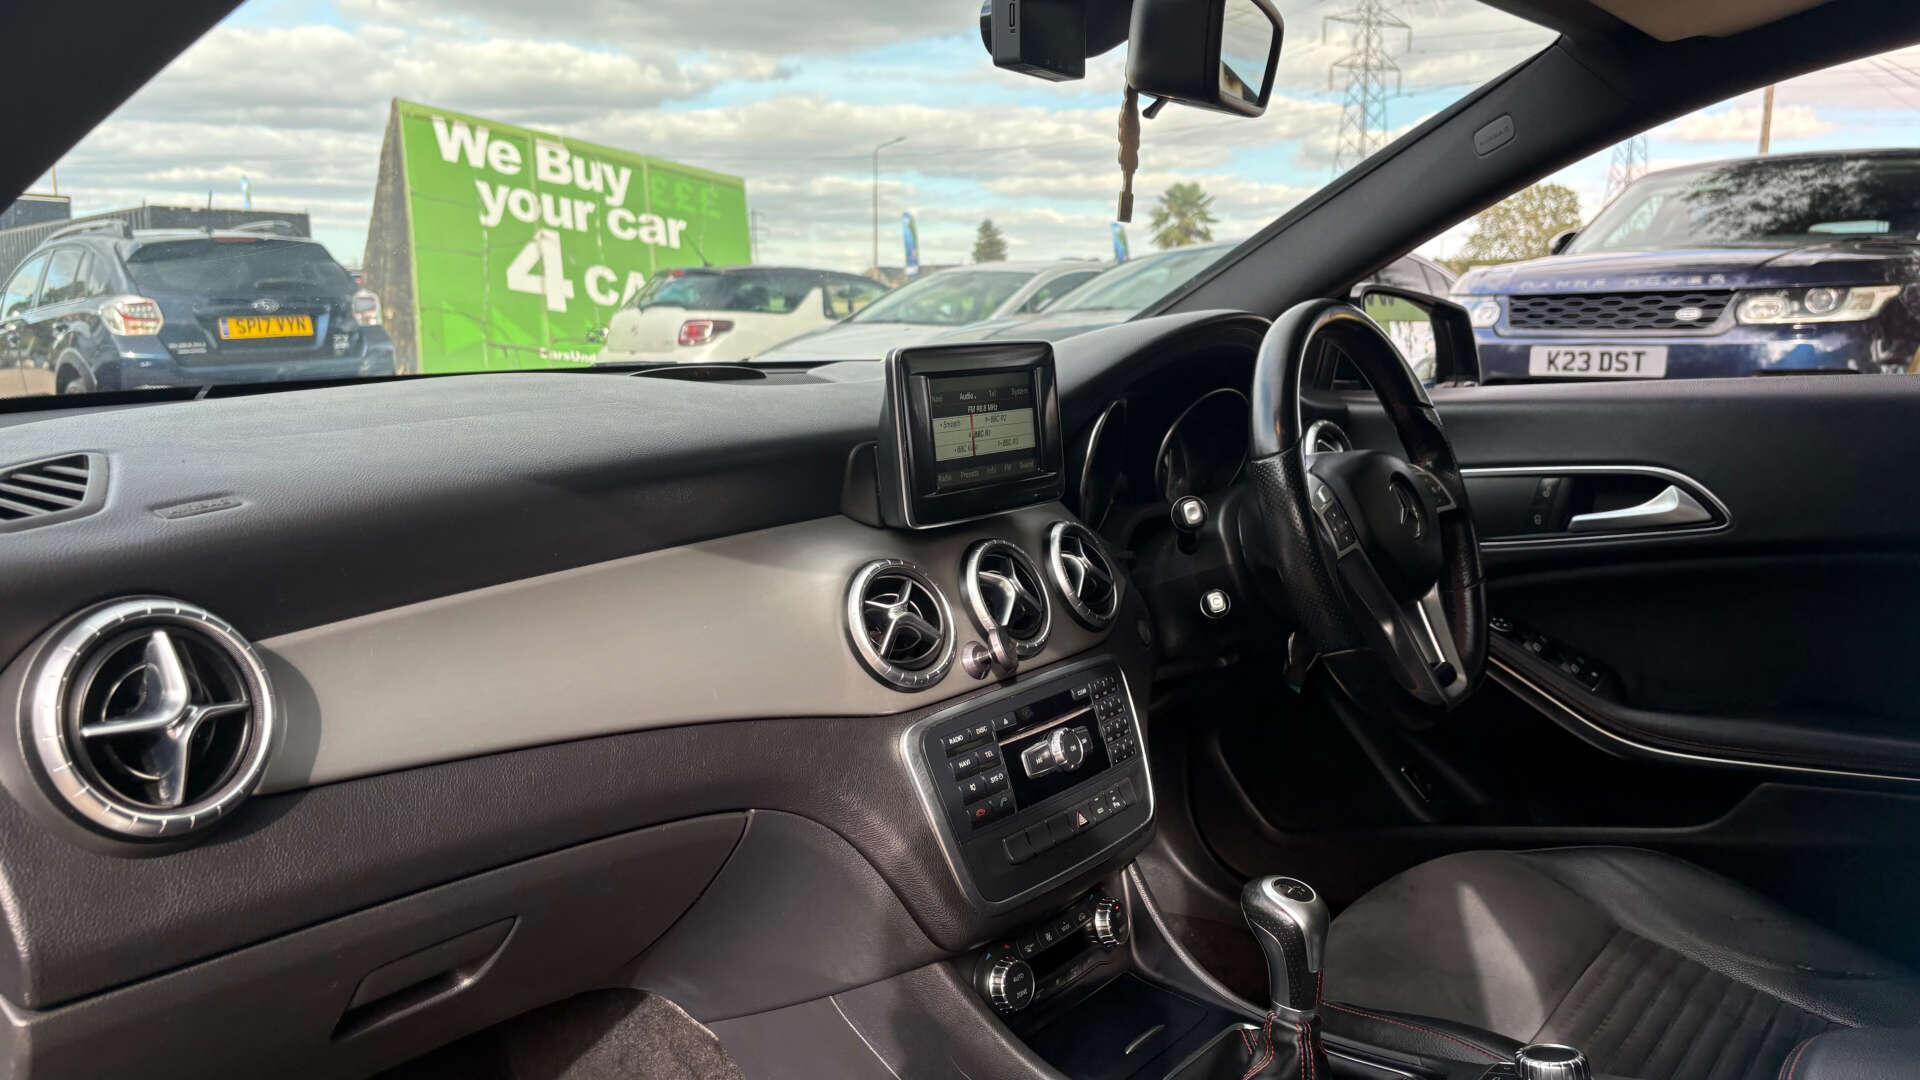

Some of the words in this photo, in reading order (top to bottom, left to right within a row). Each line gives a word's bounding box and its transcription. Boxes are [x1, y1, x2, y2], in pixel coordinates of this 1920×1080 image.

[431, 114, 523, 175] We
[534, 138, 632, 206] Buy
[475, 179, 596, 233] your
[607, 208, 687, 249] car
[506, 229, 575, 313] 4
[236, 317, 271, 335] SP17
[277, 316, 307, 333] VYN
[1546, 351, 1592, 373] K23
[1598, 351, 1646, 373] DST
[948, 734, 964, 744] RADIO
[958, 759, 971, 769] NAVI
[984, 750, 993, 759] TEL
